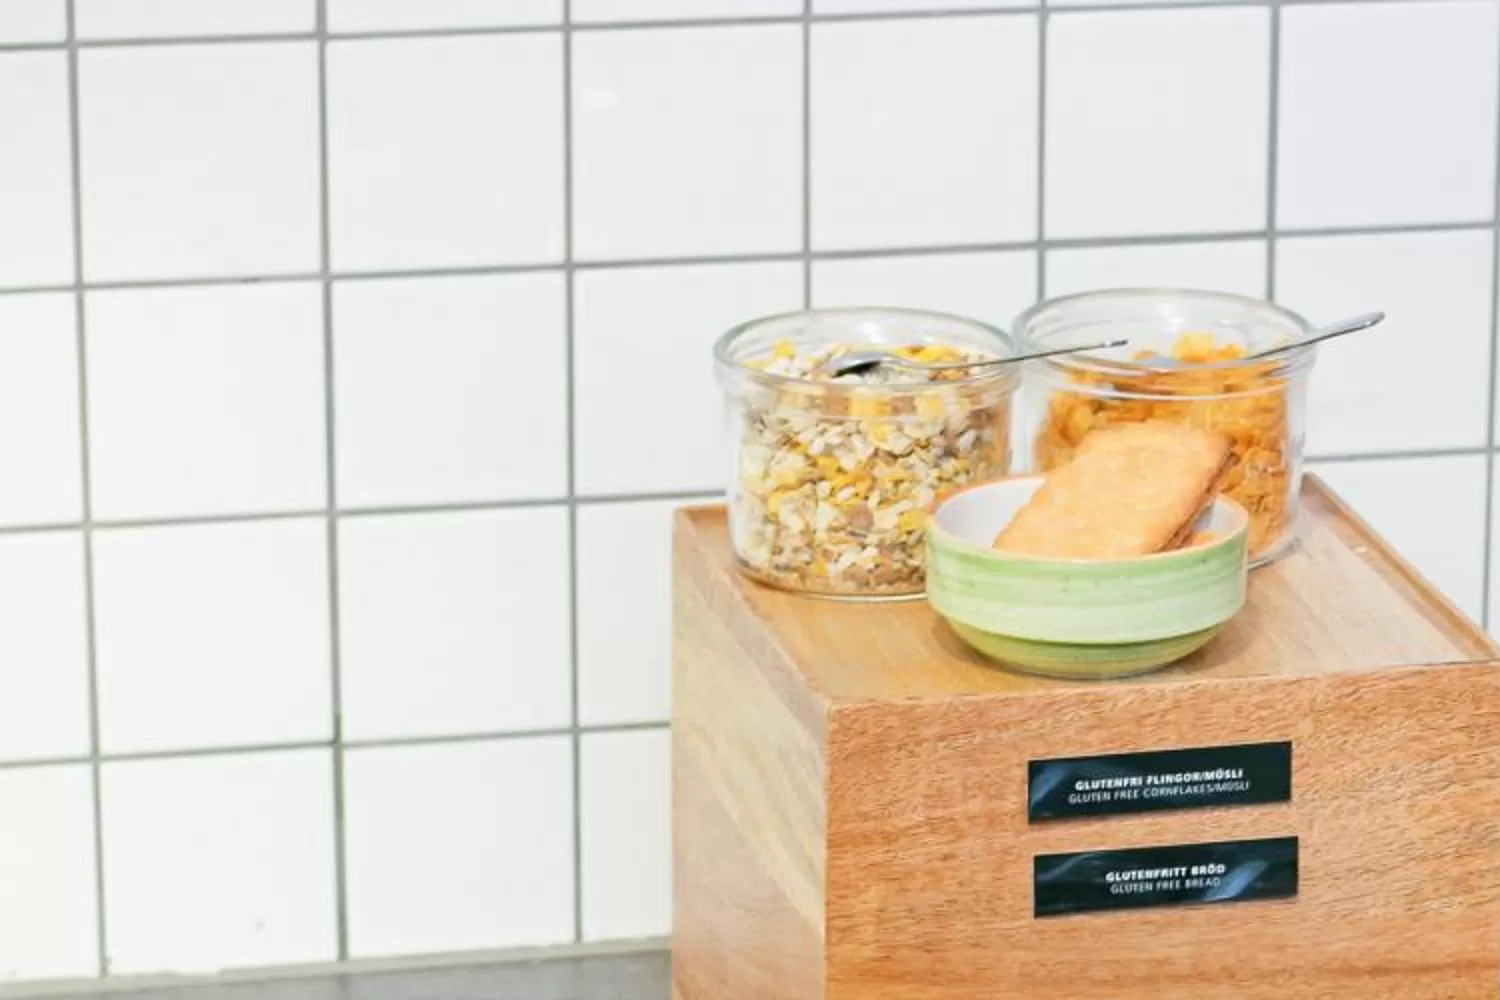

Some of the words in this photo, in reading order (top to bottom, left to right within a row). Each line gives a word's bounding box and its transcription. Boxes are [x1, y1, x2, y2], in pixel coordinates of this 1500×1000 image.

[1075, 775, 1143, 791] GLUTENFRI
[1068, 790, 1111, 805] GLUTEN
[1113, 788, 1139, 801] FREE
[1105, 867, 1187, 882] GLUTENFRITT
[1191, 863, 1226, 876] BRÖD
[1110, 881, 1153, 895] GLUTEN
[1156, 879, 1181, 891] FREE
[1185, 876, 1222, 888] BREAD
